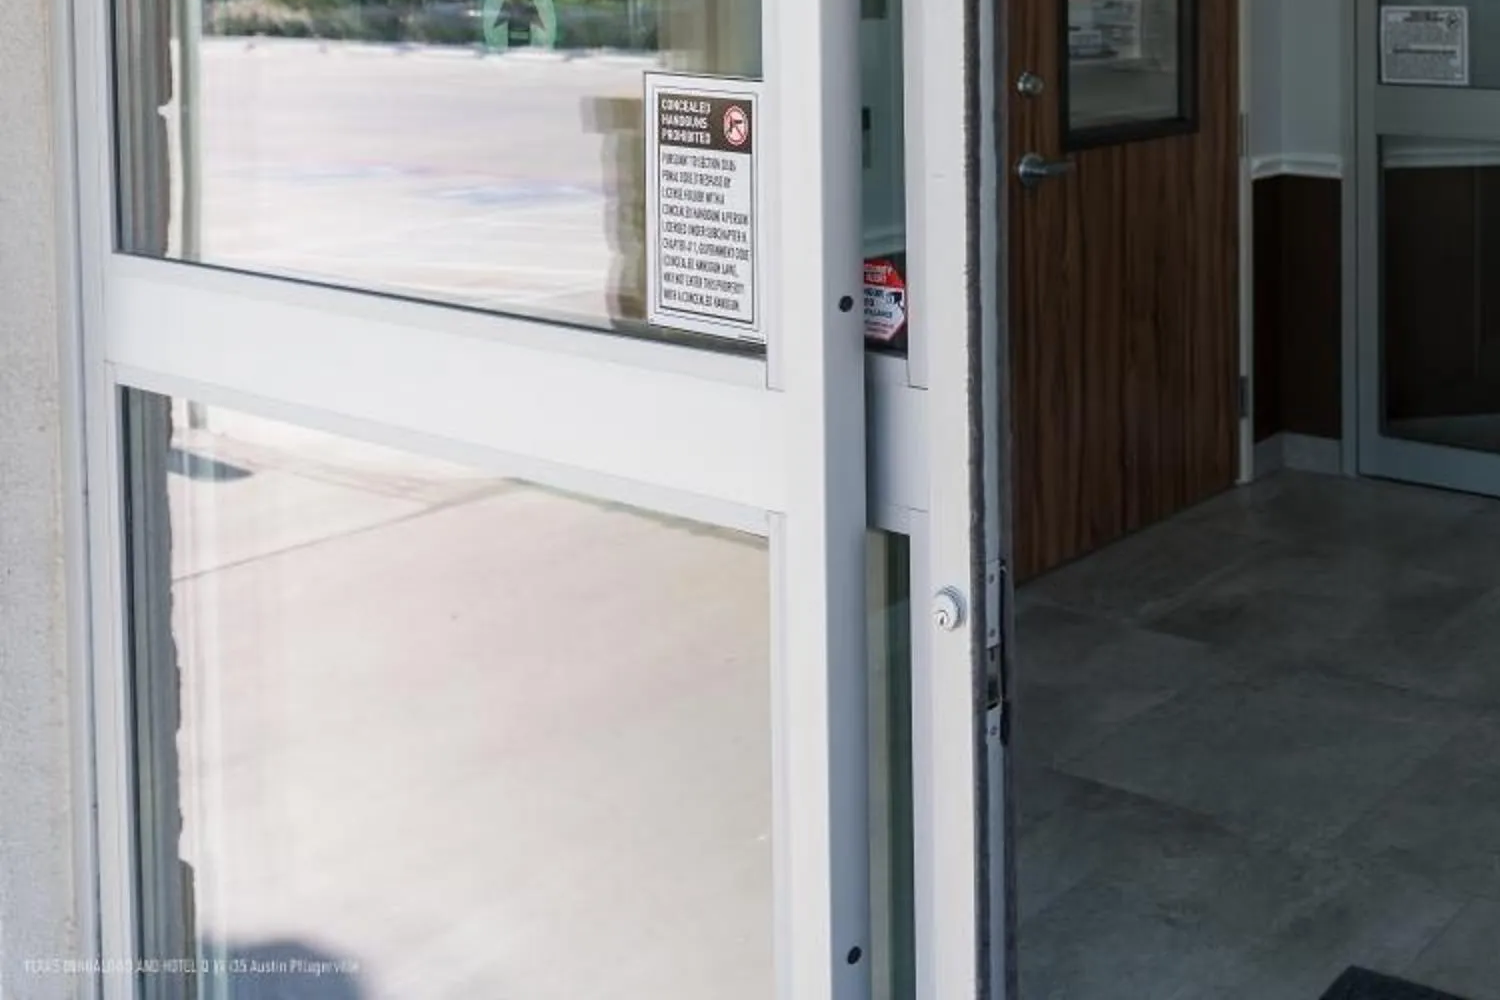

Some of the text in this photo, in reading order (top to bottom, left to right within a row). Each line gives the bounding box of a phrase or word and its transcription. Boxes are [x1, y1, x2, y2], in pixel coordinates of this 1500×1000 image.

[661, 99, 711, 114] CONCEALED
[661, 113, 708, 129] HANDGUNS
[661, 127, 711, 145] PROHIBITED
